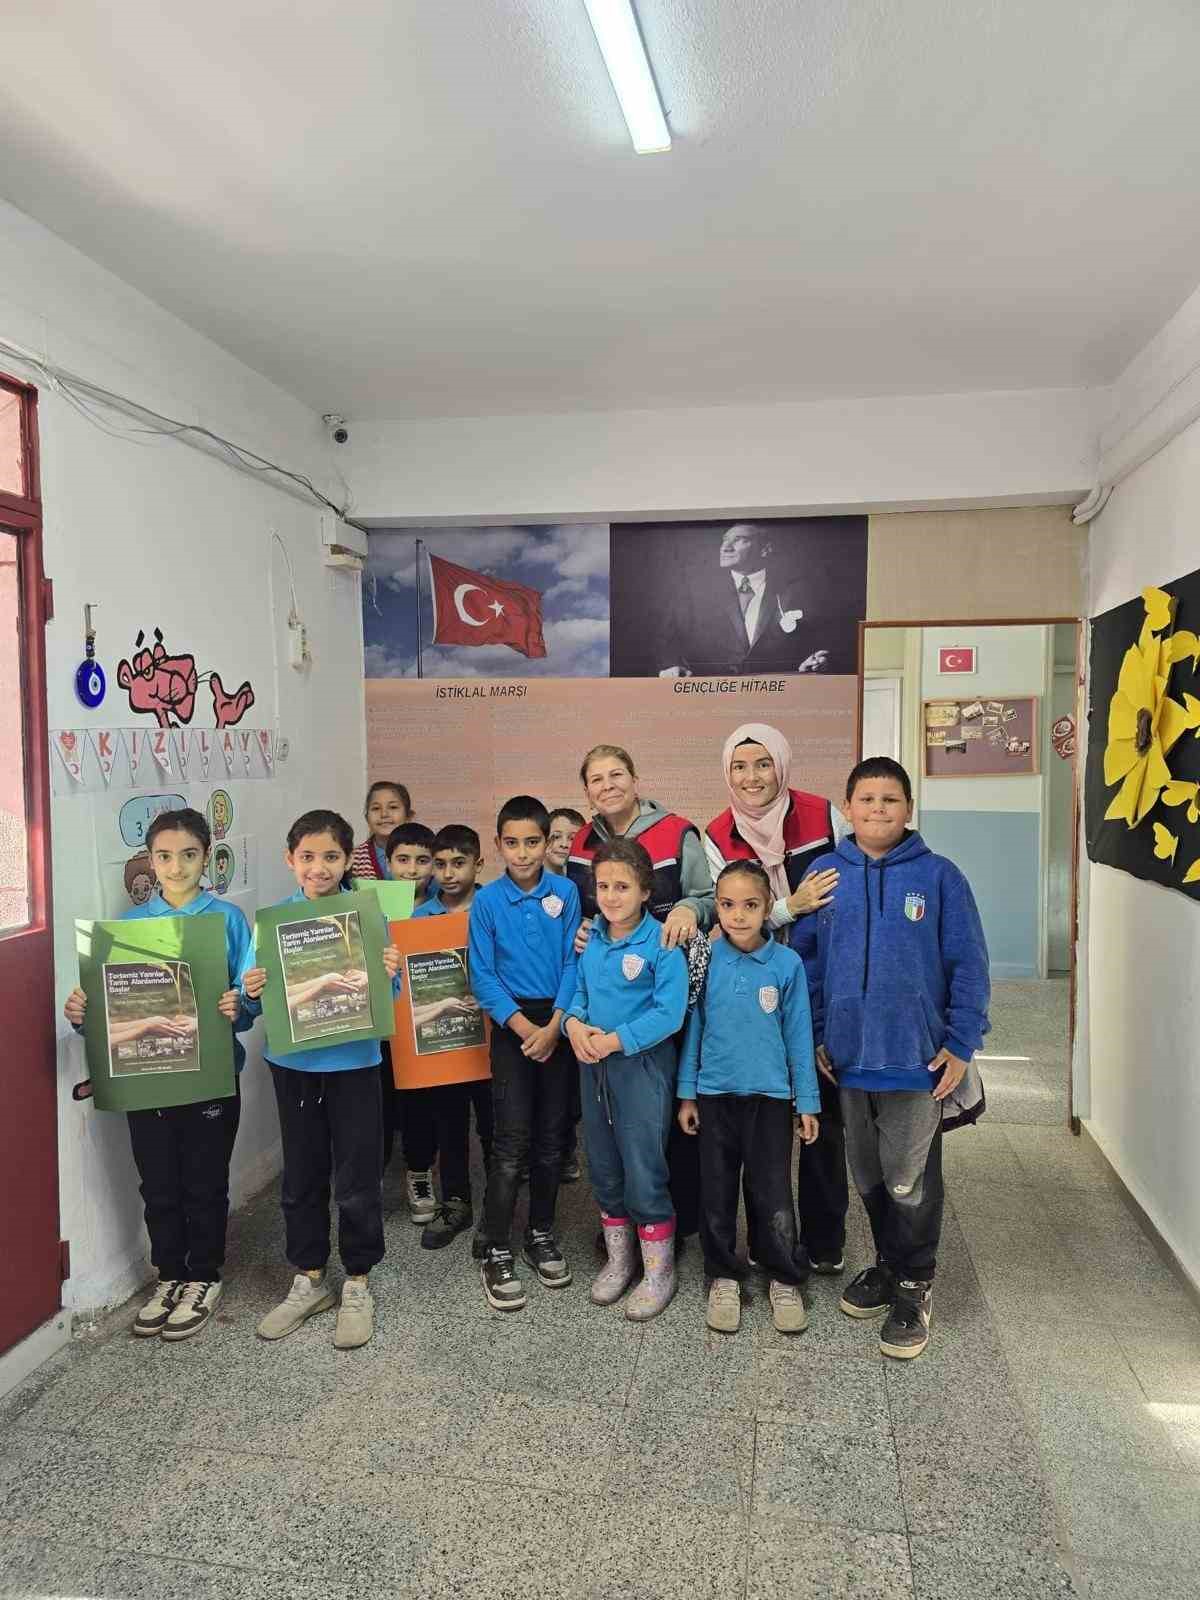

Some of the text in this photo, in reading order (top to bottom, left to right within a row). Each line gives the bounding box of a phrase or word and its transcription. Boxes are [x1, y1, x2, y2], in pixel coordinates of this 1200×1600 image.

[435, 685, 527, 700] İSTİKLAL MARŞI
[740, 678, 786, 693] HİTABE
